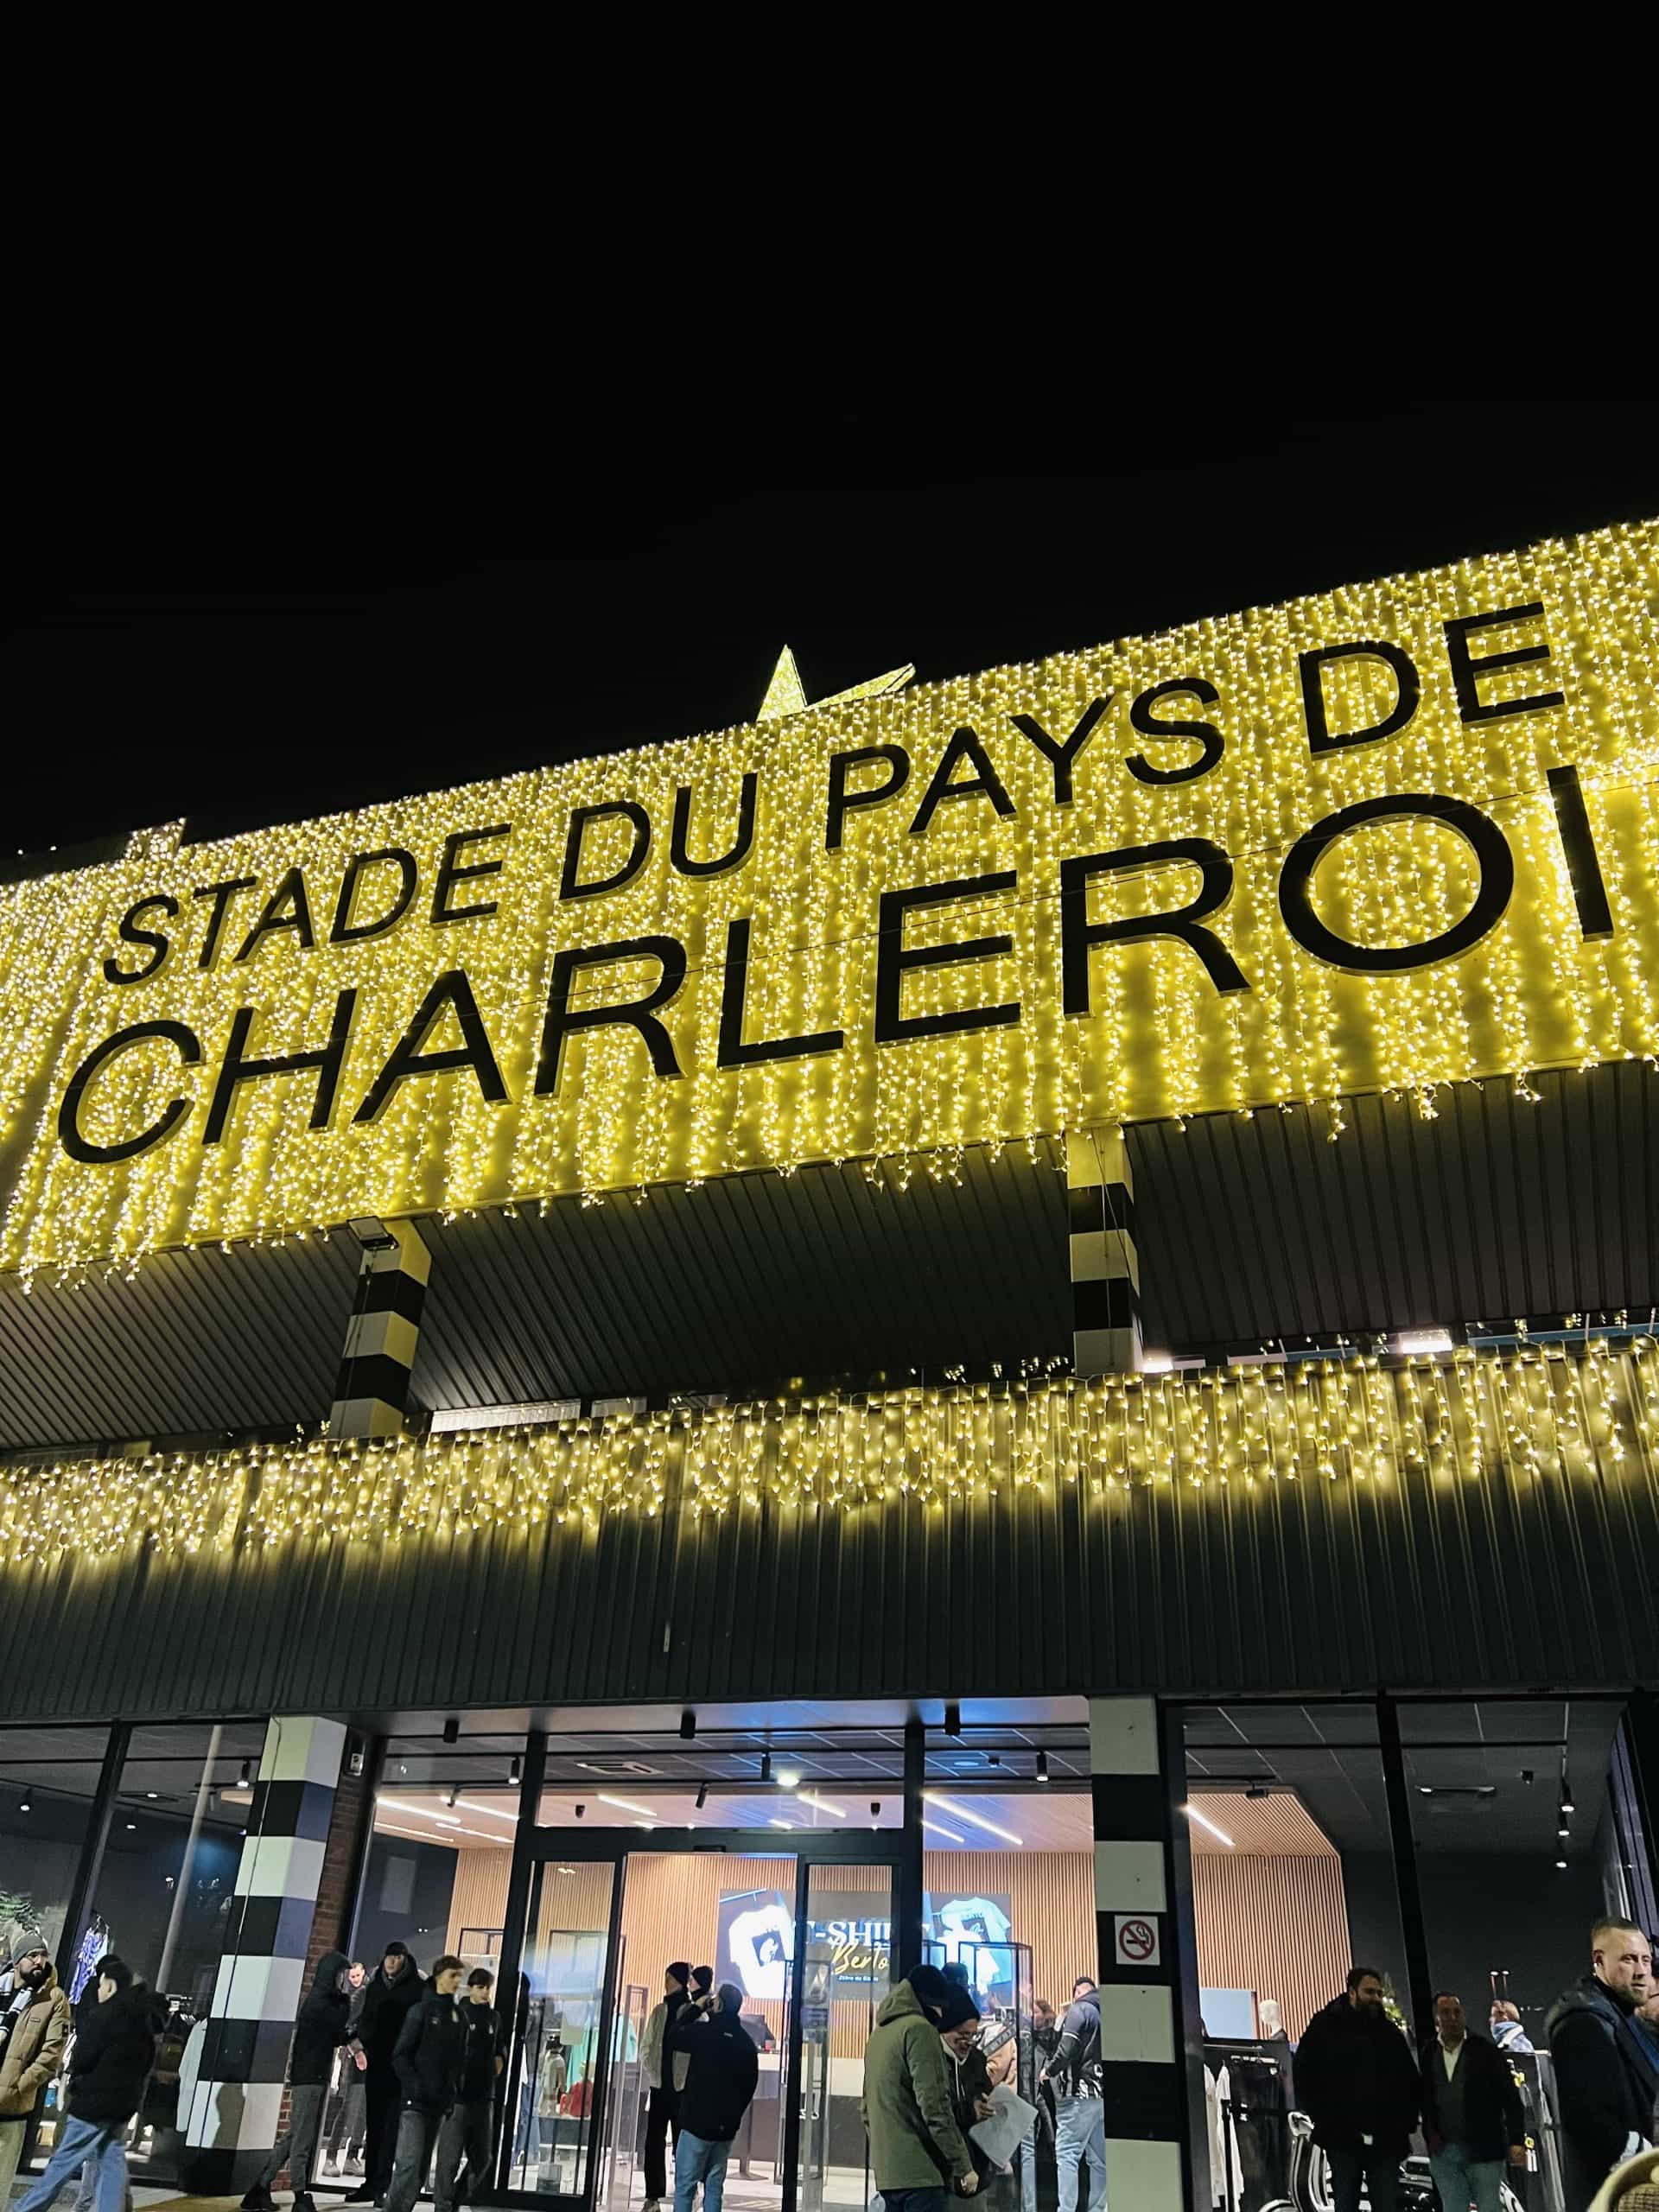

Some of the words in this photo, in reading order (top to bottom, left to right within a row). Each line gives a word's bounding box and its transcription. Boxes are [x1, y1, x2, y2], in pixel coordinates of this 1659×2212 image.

[57, 765, 1614, 1163] CHARLEROI
[103, 823, 512, 985] STADE
[559, 773, 760, 902] DU
[824, 677, 1225, 853] PAYS
[1299, 602, 1565, 757] DE
